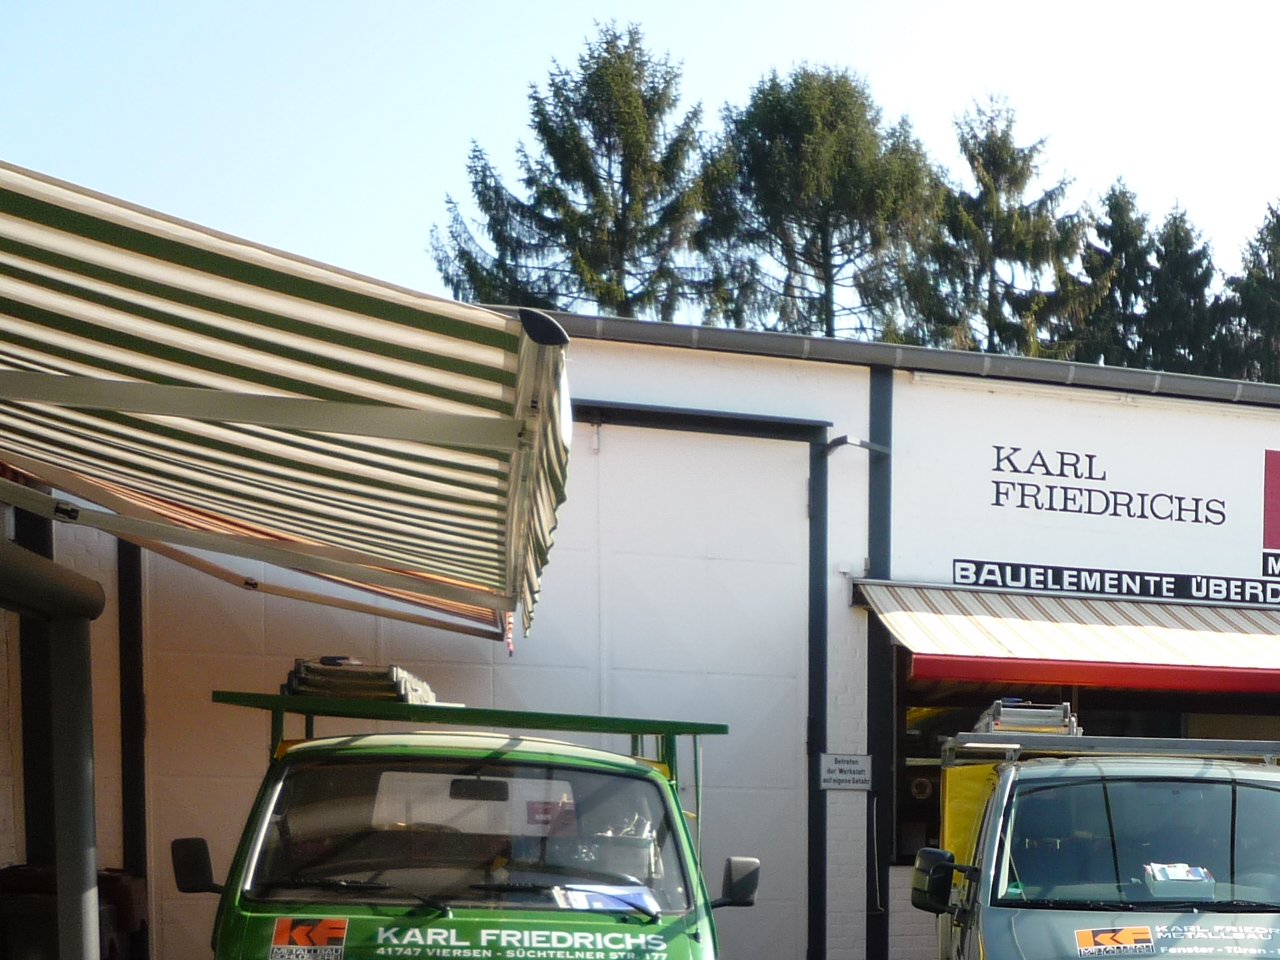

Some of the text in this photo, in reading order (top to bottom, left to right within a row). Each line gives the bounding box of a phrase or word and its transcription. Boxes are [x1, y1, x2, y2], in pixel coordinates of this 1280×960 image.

[992, 445, 1107, 481] KARL
[991, 480, 1227, 526] FRIEDRICHS
[954, 561, 1175, 597] BAUELEMENTE
[377, 927, 667, 951] KARL FRIEDRICHS
[1157, 932, 1272, 940] METALLBAU
[376, 947, 422, 956] 41747
[427, 948, 492, 957] VIERSEN
[506, 948, 605, 959] SÜCHTELNER
[1160, 946, 1215, 954] Fenster
[1224, 946, 1266, 955] Türen
